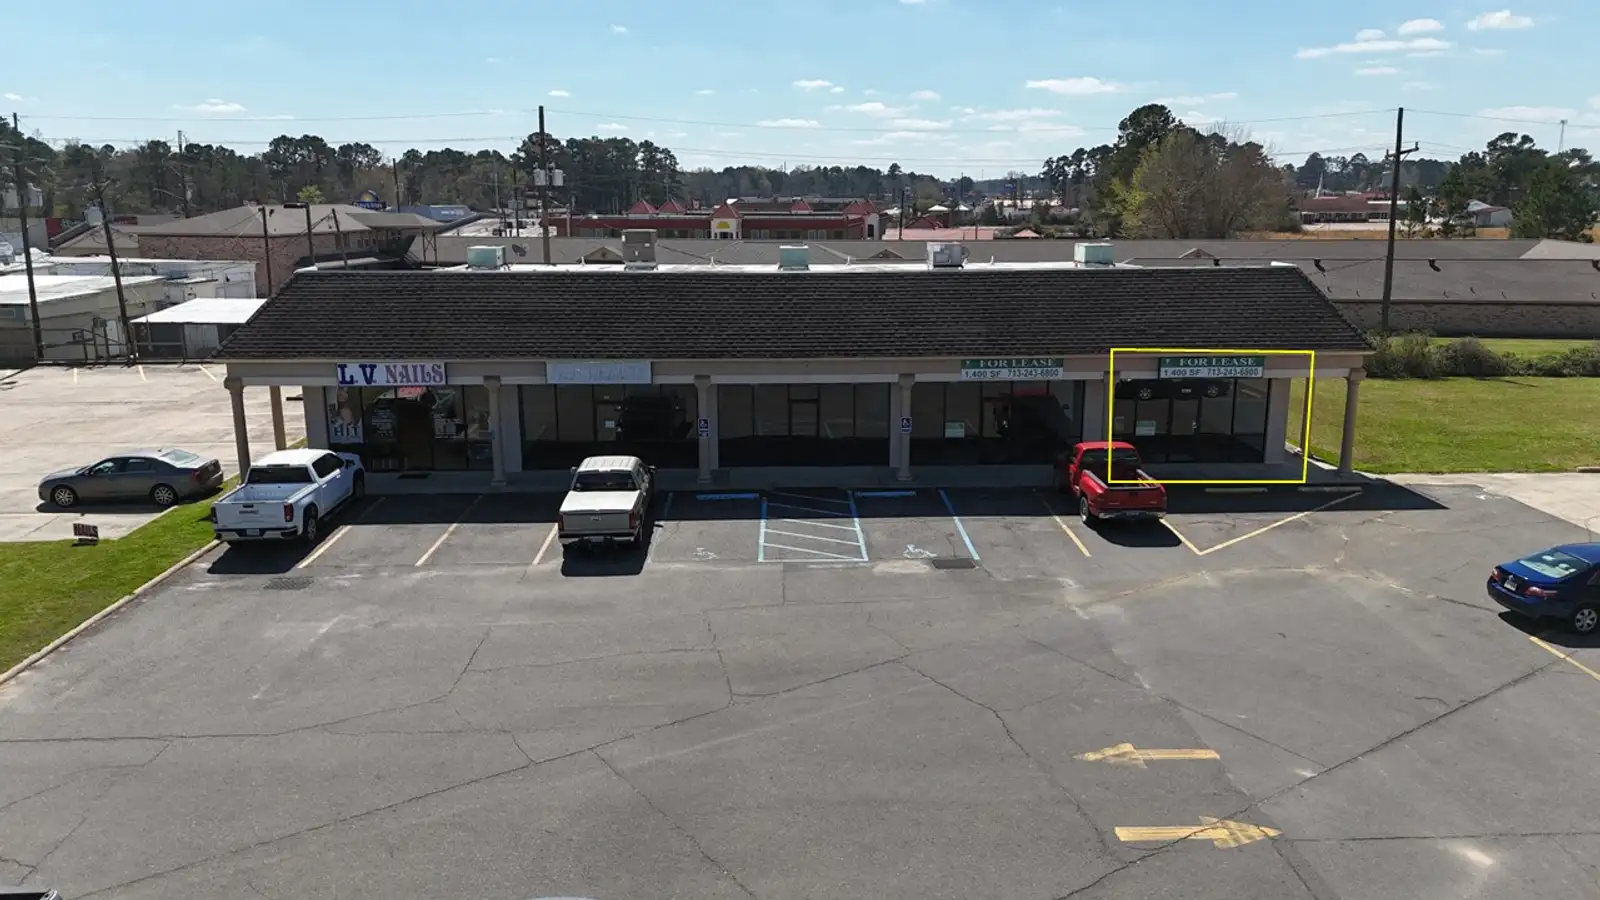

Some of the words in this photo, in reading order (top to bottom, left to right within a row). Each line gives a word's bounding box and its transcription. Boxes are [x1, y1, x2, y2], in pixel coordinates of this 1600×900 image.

[980, 360, 1007, 368] FOR
[1012, 359, 1055, 367] LEASE
[1180, 358, 1207, 366] FOR
[1212, 358, 1256, 366] LEASE
[385, 364, 443, 383] NAILS
